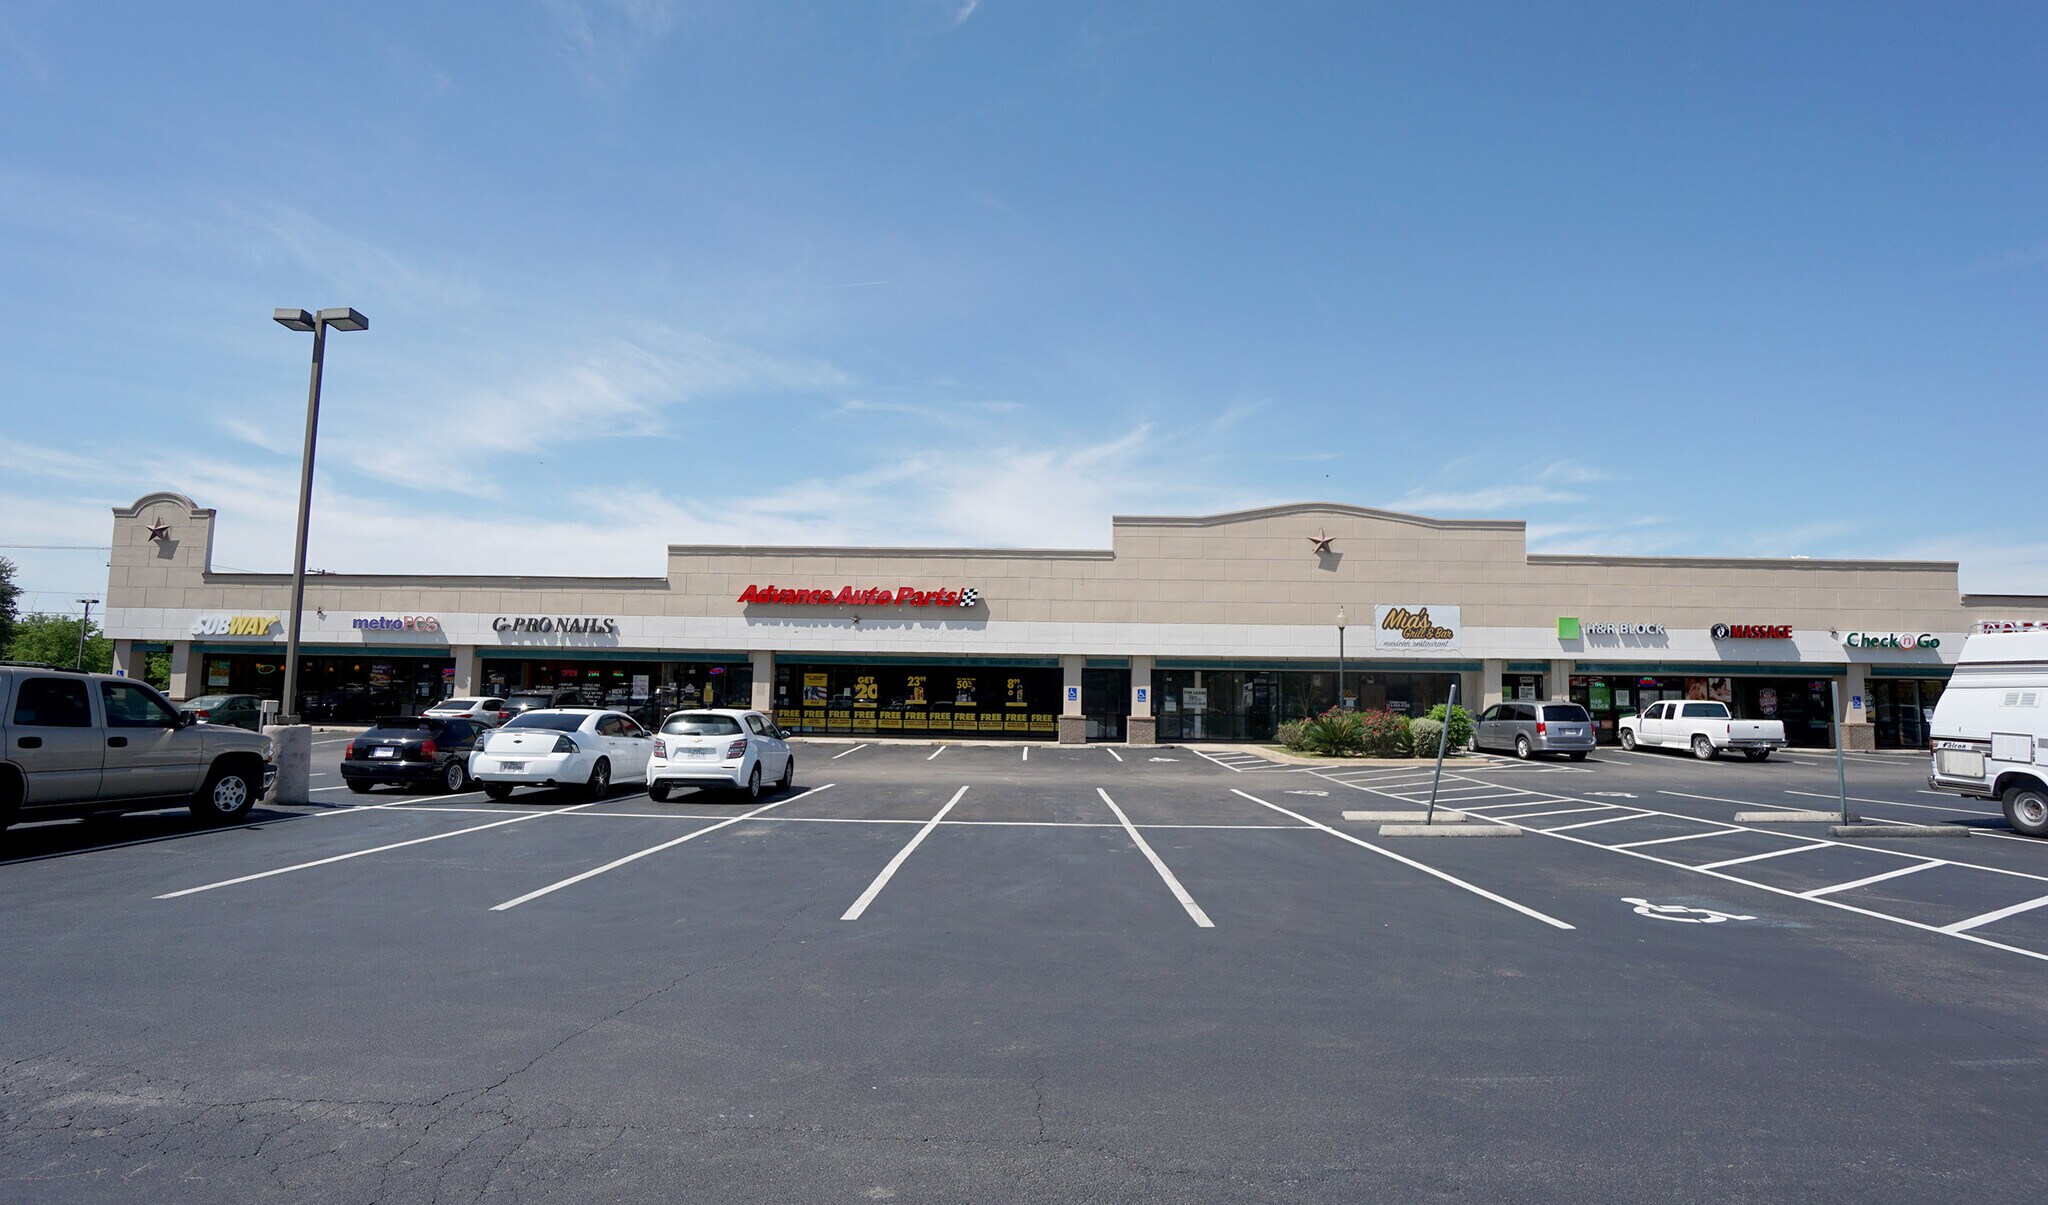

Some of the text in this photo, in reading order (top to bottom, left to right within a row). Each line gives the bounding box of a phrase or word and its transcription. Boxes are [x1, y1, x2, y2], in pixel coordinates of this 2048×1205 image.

[737, 584, 832, 605] Advance
[833, 586, 894, 605] Auto
[1382, 607, 1432, 630] Mia's
[190, 615, 279, 636] SUBWAY
[352, 616, 438, 632] metroPCS
[492, 617, 614, 634] G-PRO NAILS
[1402, 627, 1454, 639] Grill & Bar
[1585, 623, 1666, 636] H&R BLOCK
[1730, 625, 1793, 639] MASSAGE
[1846, 632, 1898, 648] Check
[1917, 633, 1941, 649] Go
[857, 676, 875, 684] GET
[779, 709, 800, 718] FREE
[803, 710, 826, 718] FREE
[828, 710, 851, 718] FREE
[854, 710, 876, 719] FREE
[880, 711, 902, 719] FREE
[905, 711, 927, 720] FREE
[929, 712, 951, 720] FREE
[954, 712, 976, 720] FREE
[980, 713, 1002, 721] FREE
[1005, 713, 1028, 721] FREE
[1031, 714, 1053, 722] FREE
